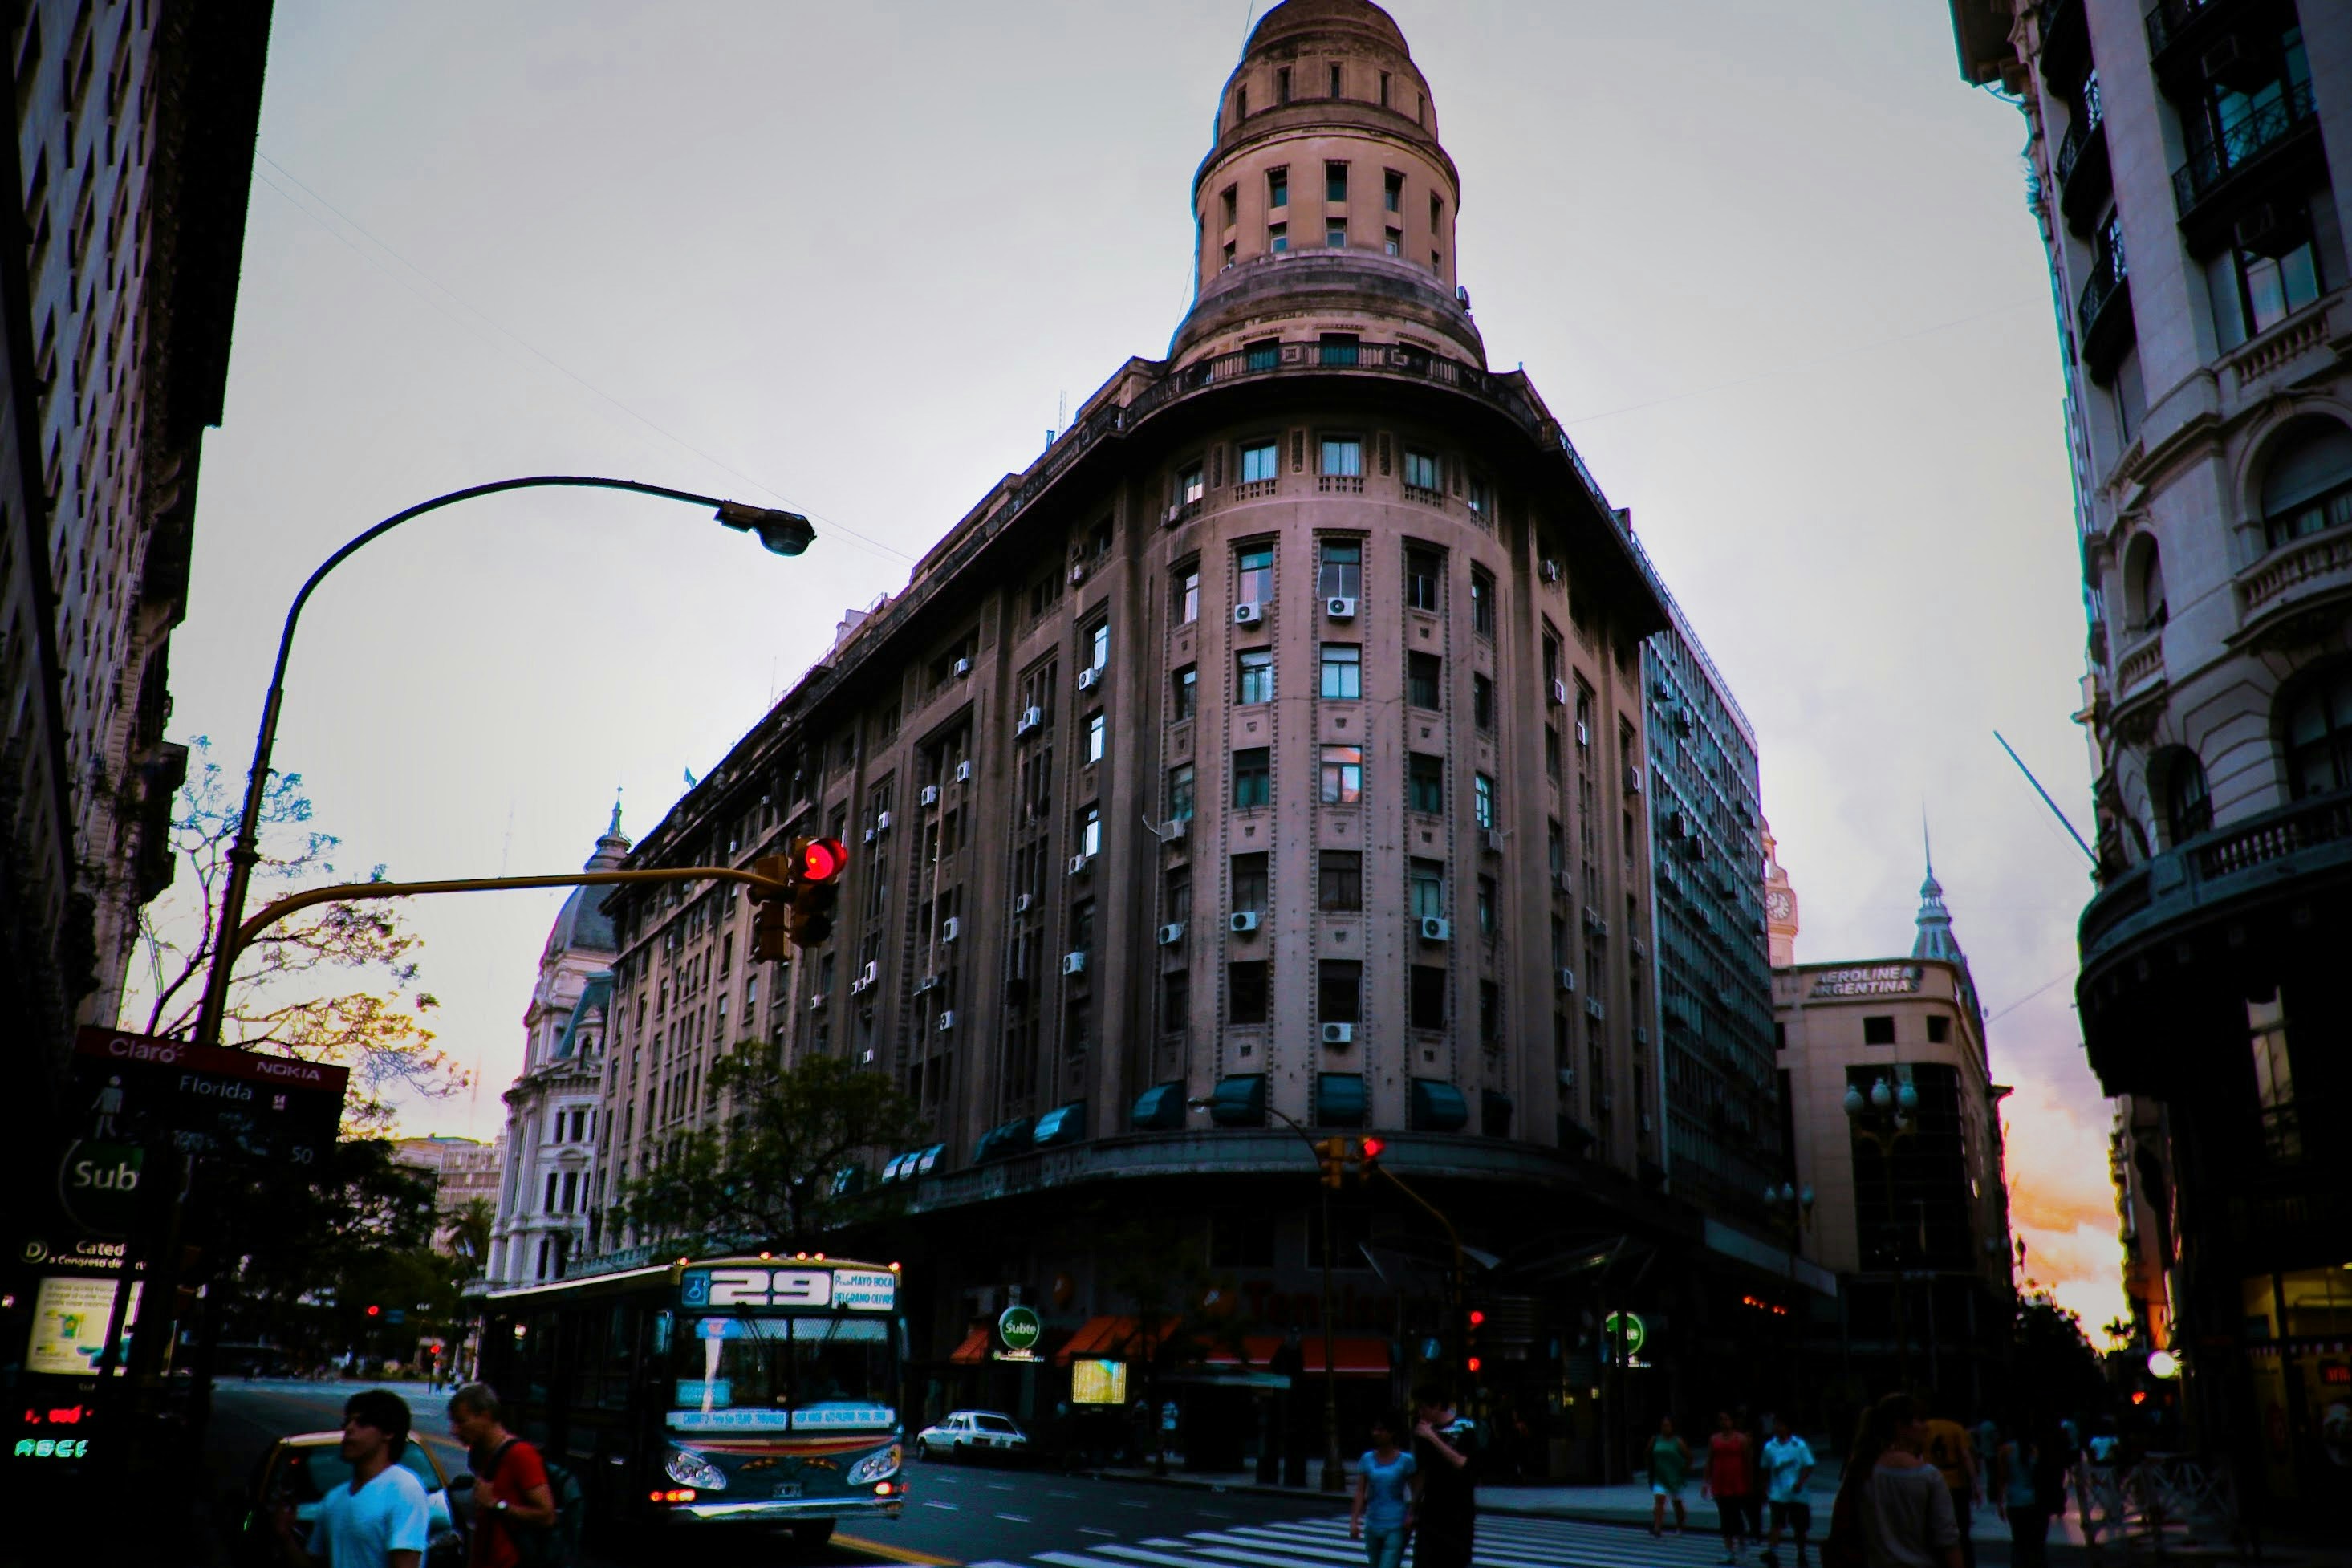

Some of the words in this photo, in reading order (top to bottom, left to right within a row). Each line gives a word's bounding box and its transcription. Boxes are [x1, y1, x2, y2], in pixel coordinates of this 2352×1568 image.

[1810, 980, 1919, 997] ARGENTINAS
[108, 1037, 177, 1064] Claro
[255, 1061, 321, 1082] NOKIA
[178, 1073, 254, 1102] Florida
[72, 1160, 140, 1192] Sub
[76, 1239, 127, 1257] Cated
[709, 1269, 831, 1306] 29
[1005, 1320, 1037, 1335] Subte
